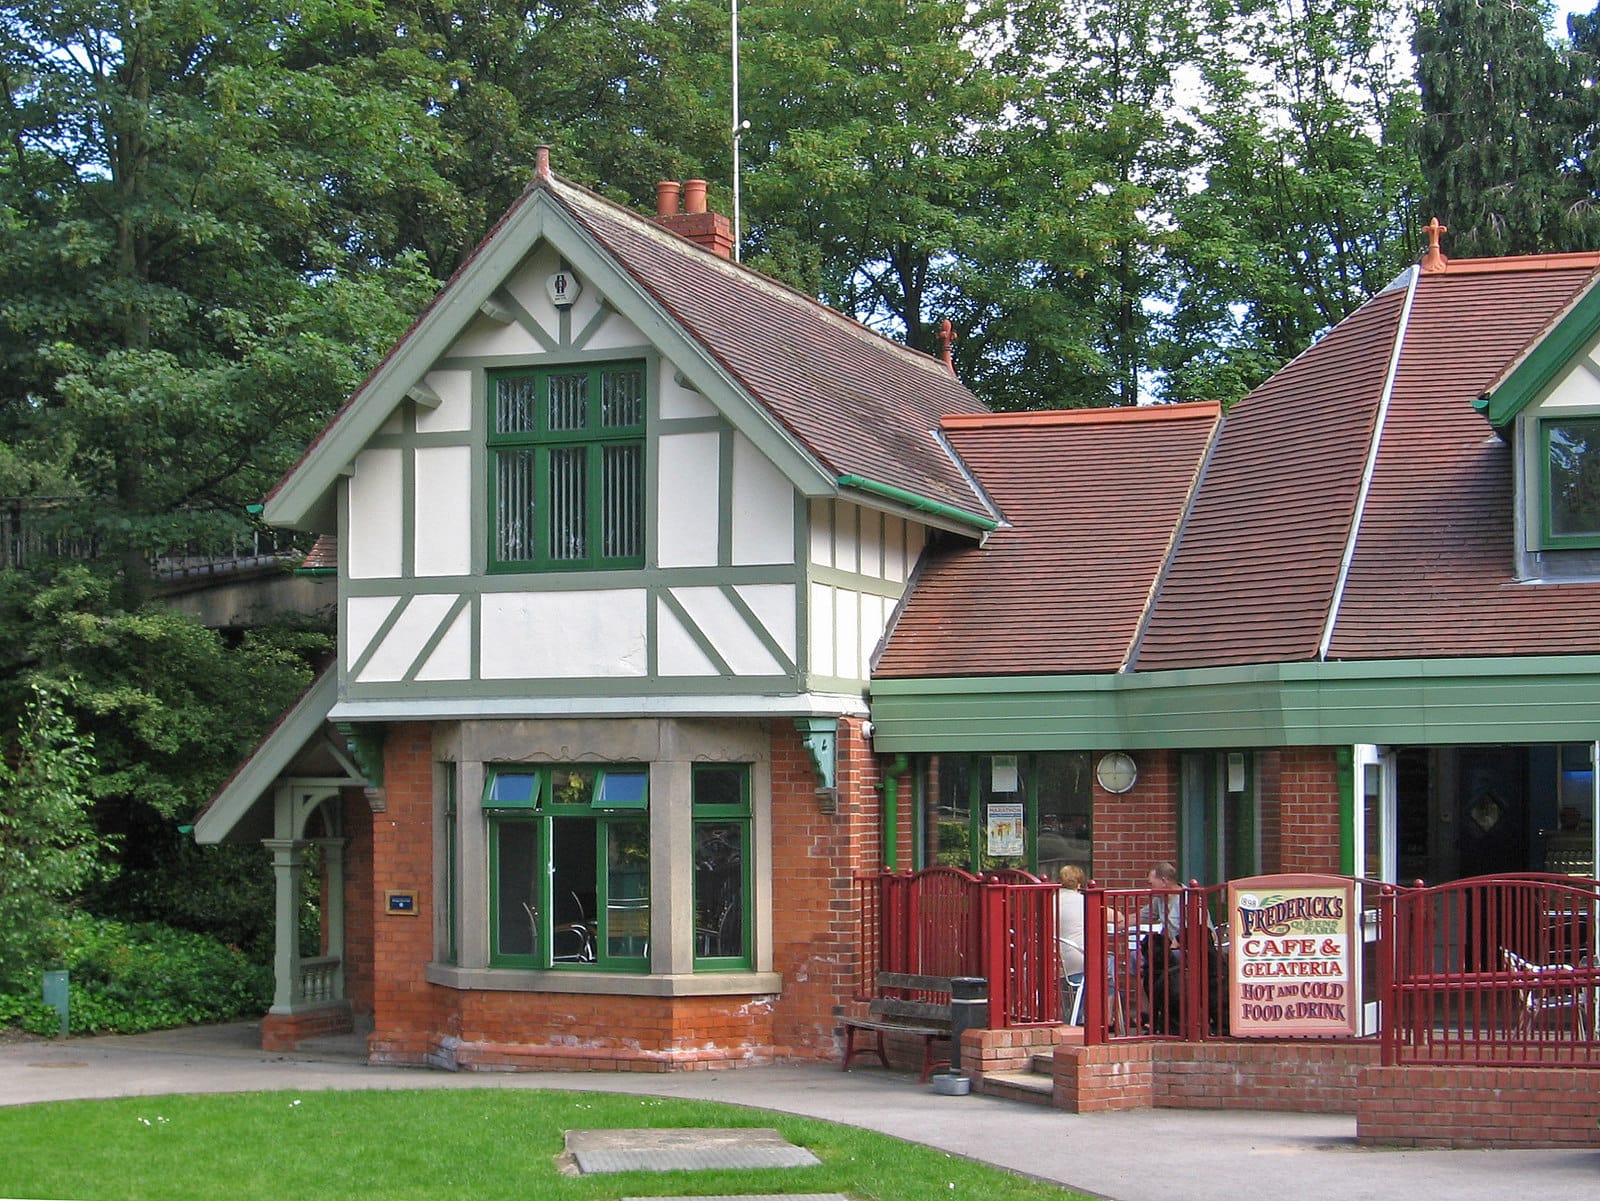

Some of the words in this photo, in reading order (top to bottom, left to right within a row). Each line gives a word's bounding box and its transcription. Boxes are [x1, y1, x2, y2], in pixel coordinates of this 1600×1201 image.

[1237, 896, 1344, 938] FREDERICK'S
[1290, 920, 1339, 929] QUEENS
[1304, 927, 1338, 935] PARK
[1243, 939, 1316, 957] CAFE
[1320, 938, 1341, 957] &
[1242, 961, 1343, 978] GELATERIA
[1240, 983, 1275, 1002] HOT
[1277, 984, 1299, 998] AND
[1300, 981, 1344, 1000] COLD
[1241, 1003, 1283, 1021] FOOD
